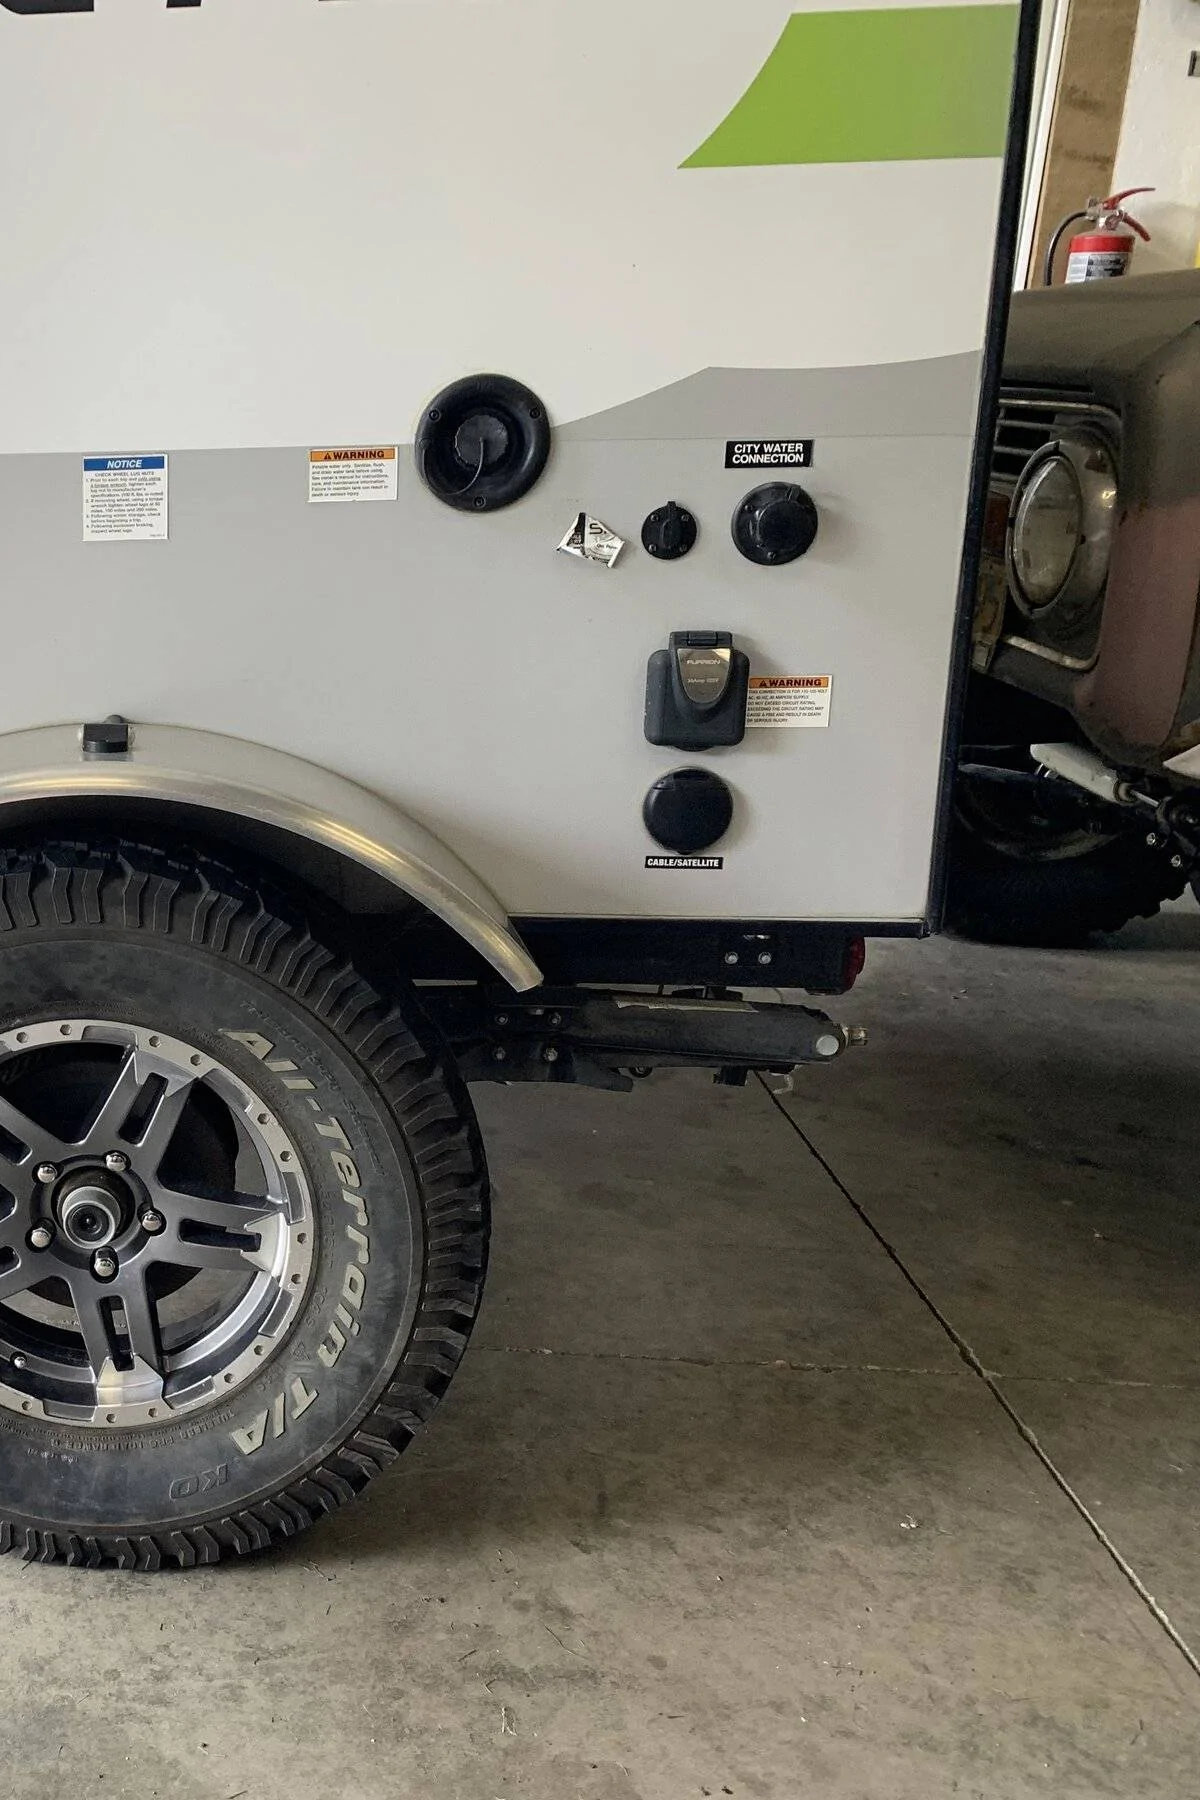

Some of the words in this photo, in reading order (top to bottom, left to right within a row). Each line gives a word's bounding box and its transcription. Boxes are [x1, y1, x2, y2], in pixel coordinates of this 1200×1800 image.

[734, 443, 761, 454] CITY
[763, 442, 804, 453] WATER
[333, 450, 385, 460] WARNING
[732, 453, 804, 464] CONNECTION
[107, 459, 143, 470] NOTICE
[769, 679, 822, 687] WARNING
[646, 857, 720, 867] CABLE/SATELLITE
[217, 1027, 371, 1368] All-Terrain
[229, 1377, 319, 1456] T/A
